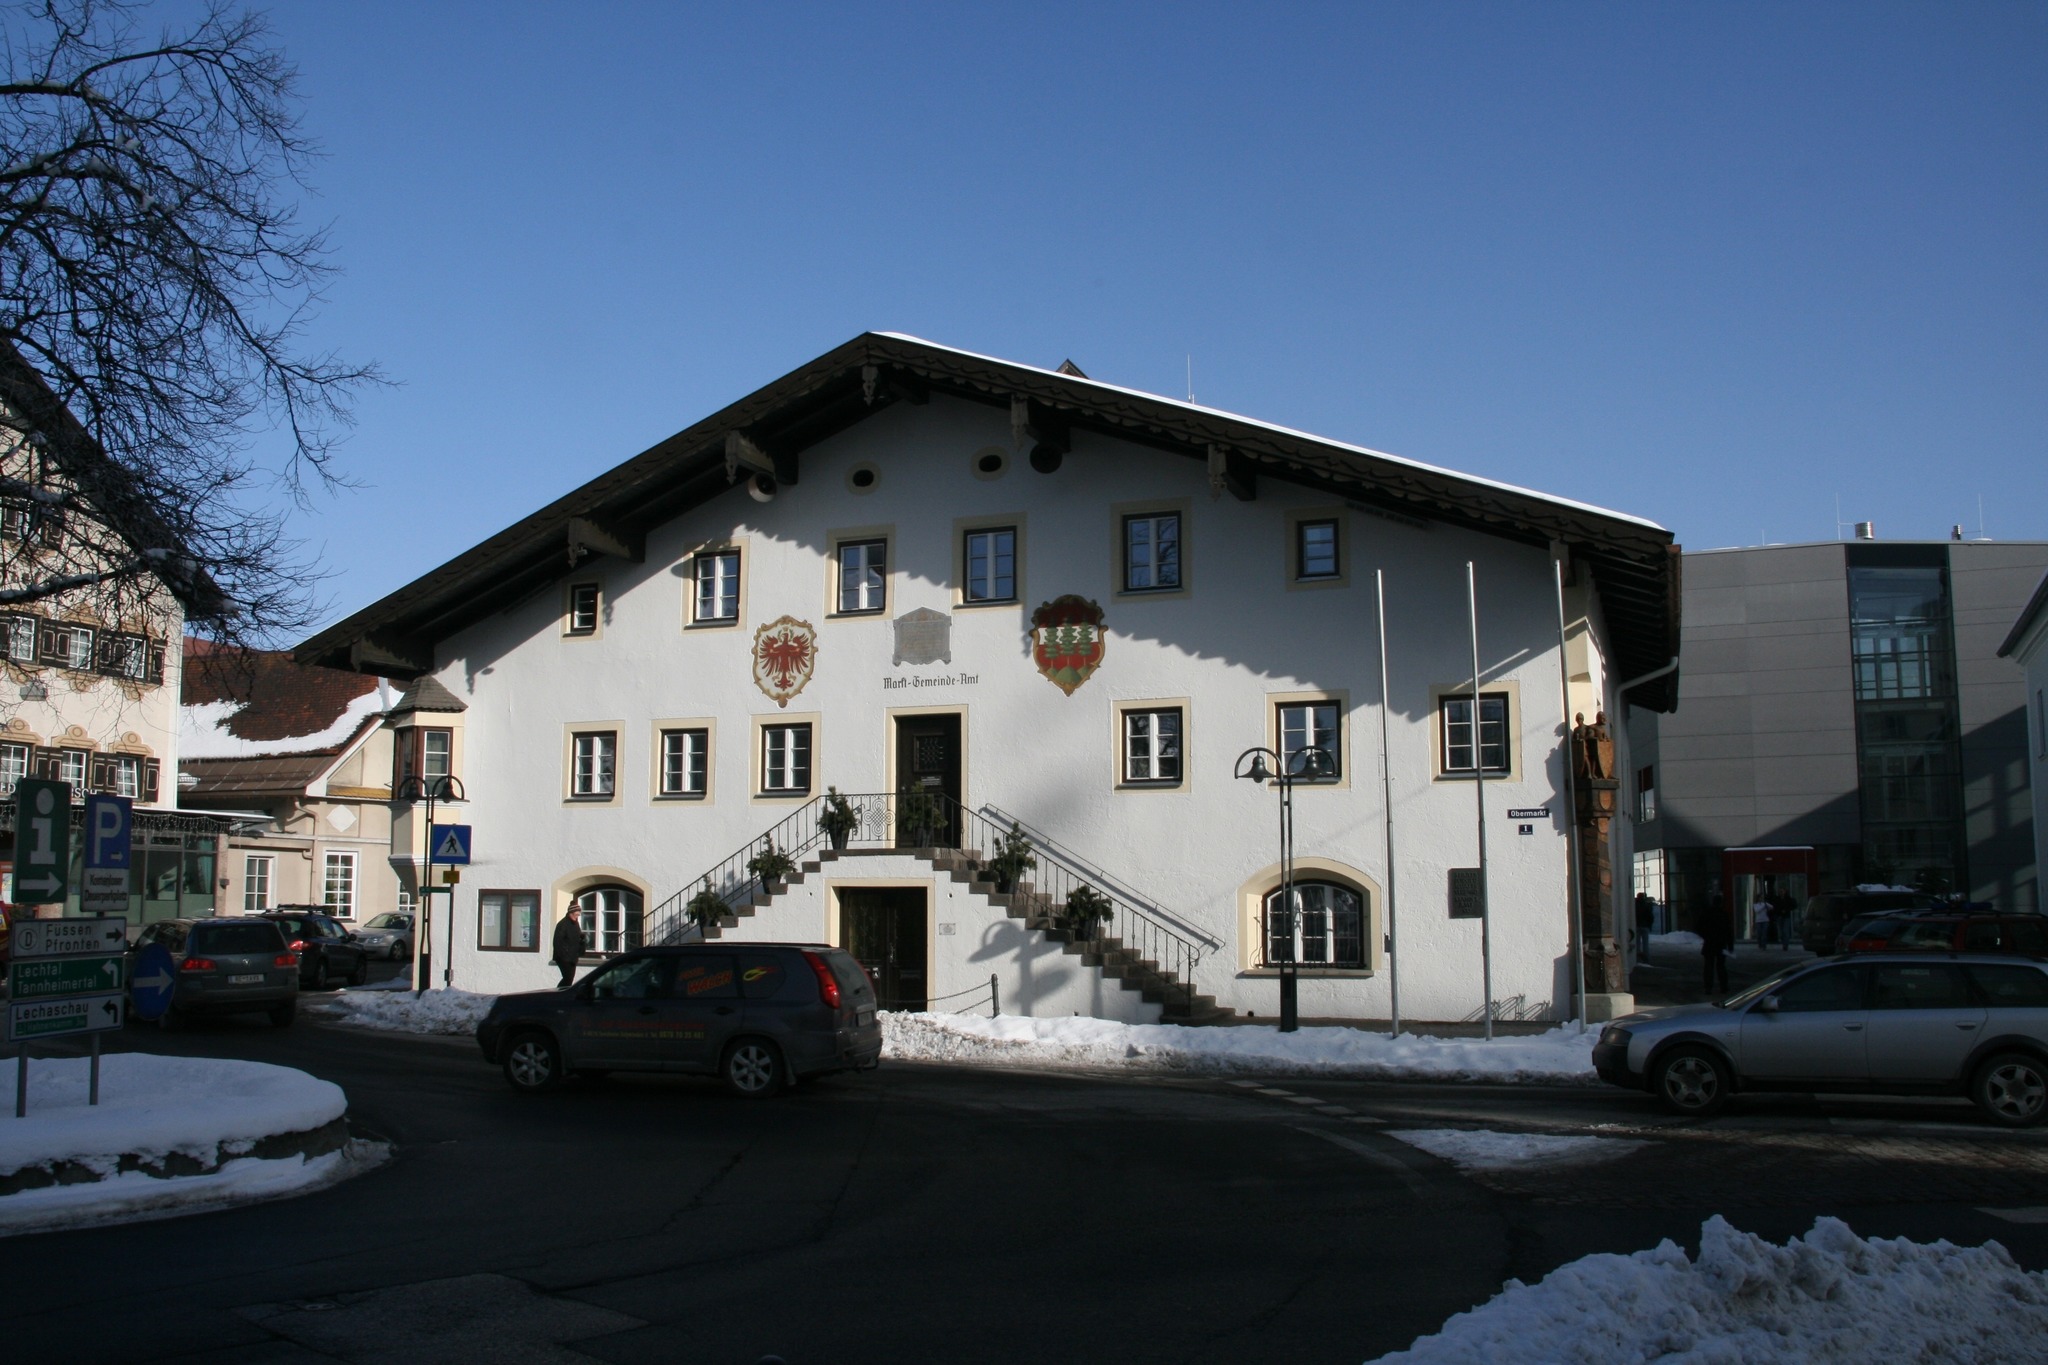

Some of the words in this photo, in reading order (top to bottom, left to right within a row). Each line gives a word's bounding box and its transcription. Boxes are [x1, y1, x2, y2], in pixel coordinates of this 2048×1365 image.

[93, 802, 123, 865] P
[46, 923, 92, 937] Füssen
[25, 932, 33, 947] D
[45, 939, 100, 952] Pfronten
[18, 962, 62, 978] Lechtal
[17, 975, 97, 994] Tannheimertal
[16, 1001, 89, 1020] Lechaschau
